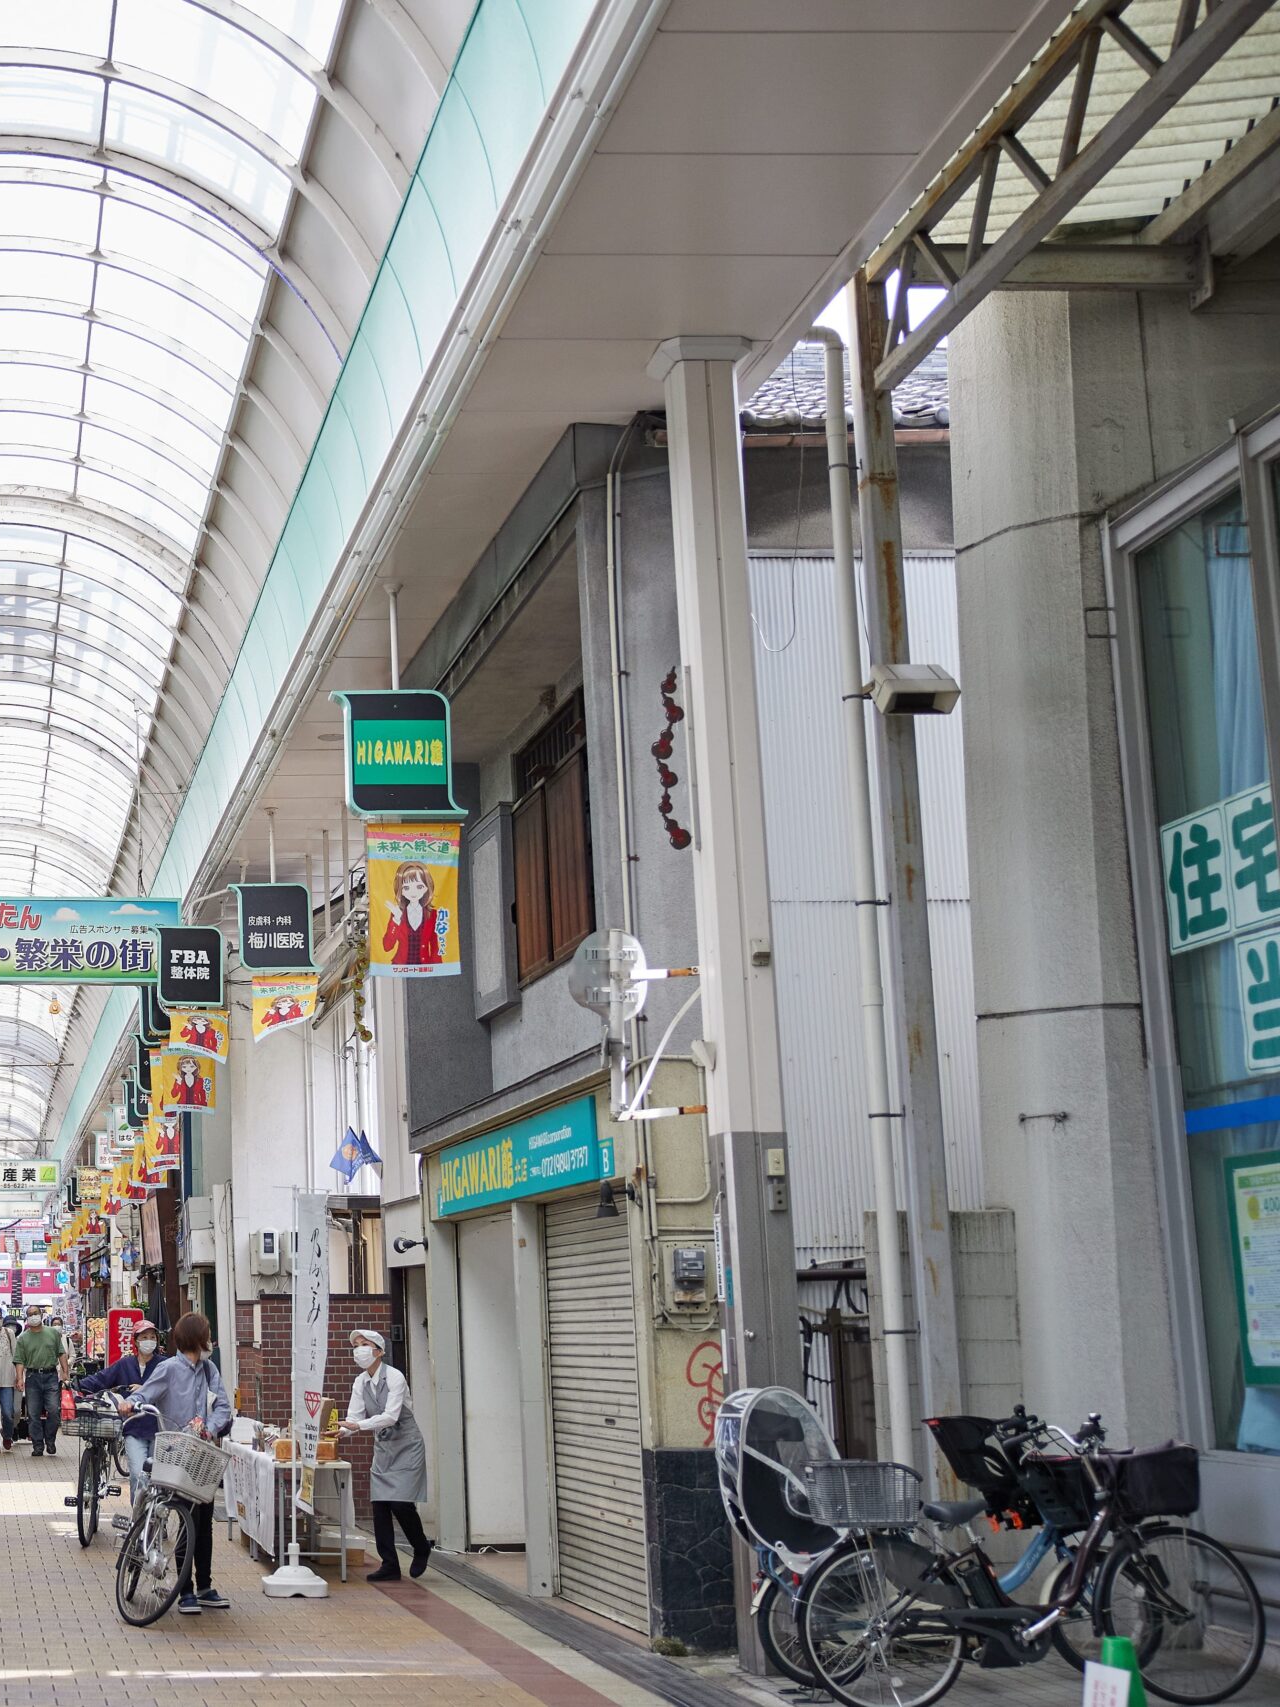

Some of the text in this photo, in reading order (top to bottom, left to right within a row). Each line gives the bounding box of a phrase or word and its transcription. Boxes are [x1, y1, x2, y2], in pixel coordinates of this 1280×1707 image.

[376, 840, 451, 854] 未来へ続く道
[247, 915, 293, 926] 皮膚科・内科
[247, 932, 305, 949] 梅川医院
[170, 949, 211, 965] FBA
[170, 966, 210, 980] 整体院
[117, 1316, 135, 1358] 処方せ
